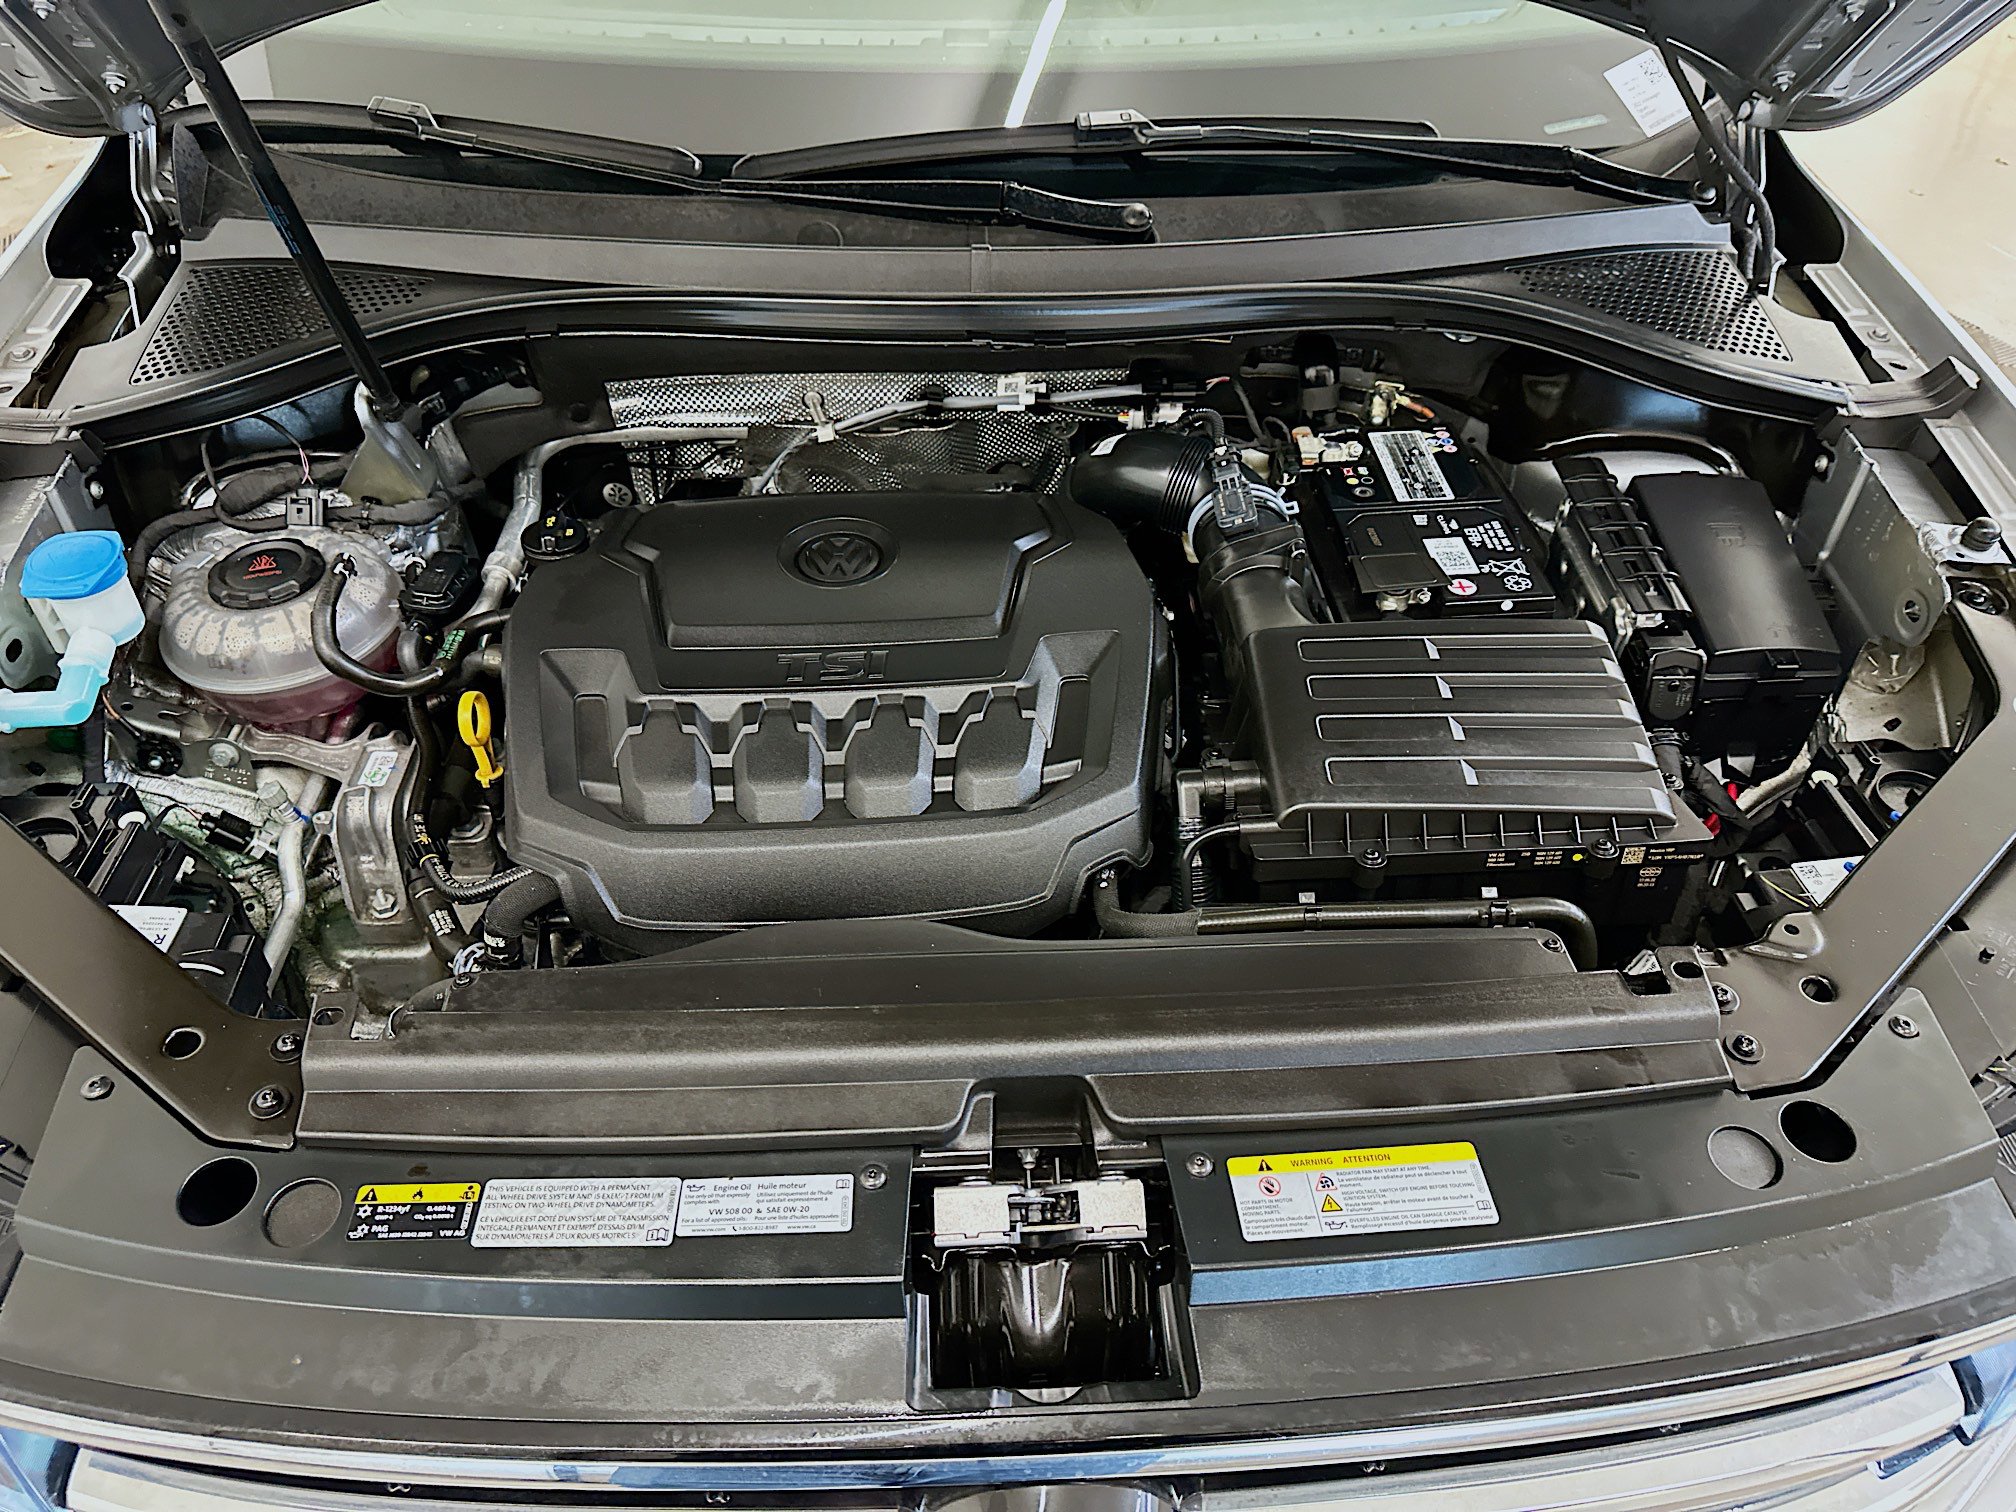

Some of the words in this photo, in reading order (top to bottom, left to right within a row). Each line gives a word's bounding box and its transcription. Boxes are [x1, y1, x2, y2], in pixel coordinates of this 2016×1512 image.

[803, 534, 875, 579] VW
[777, 650, 889, 683] TSI
[1291, 1157, 1333, 1167] WARNING
[1343, 1153, 1391, 1163] ATTENTION
[376, 1205, 411, 1214] R-1234yf
[371, 1224, 389, 1232] PAG
